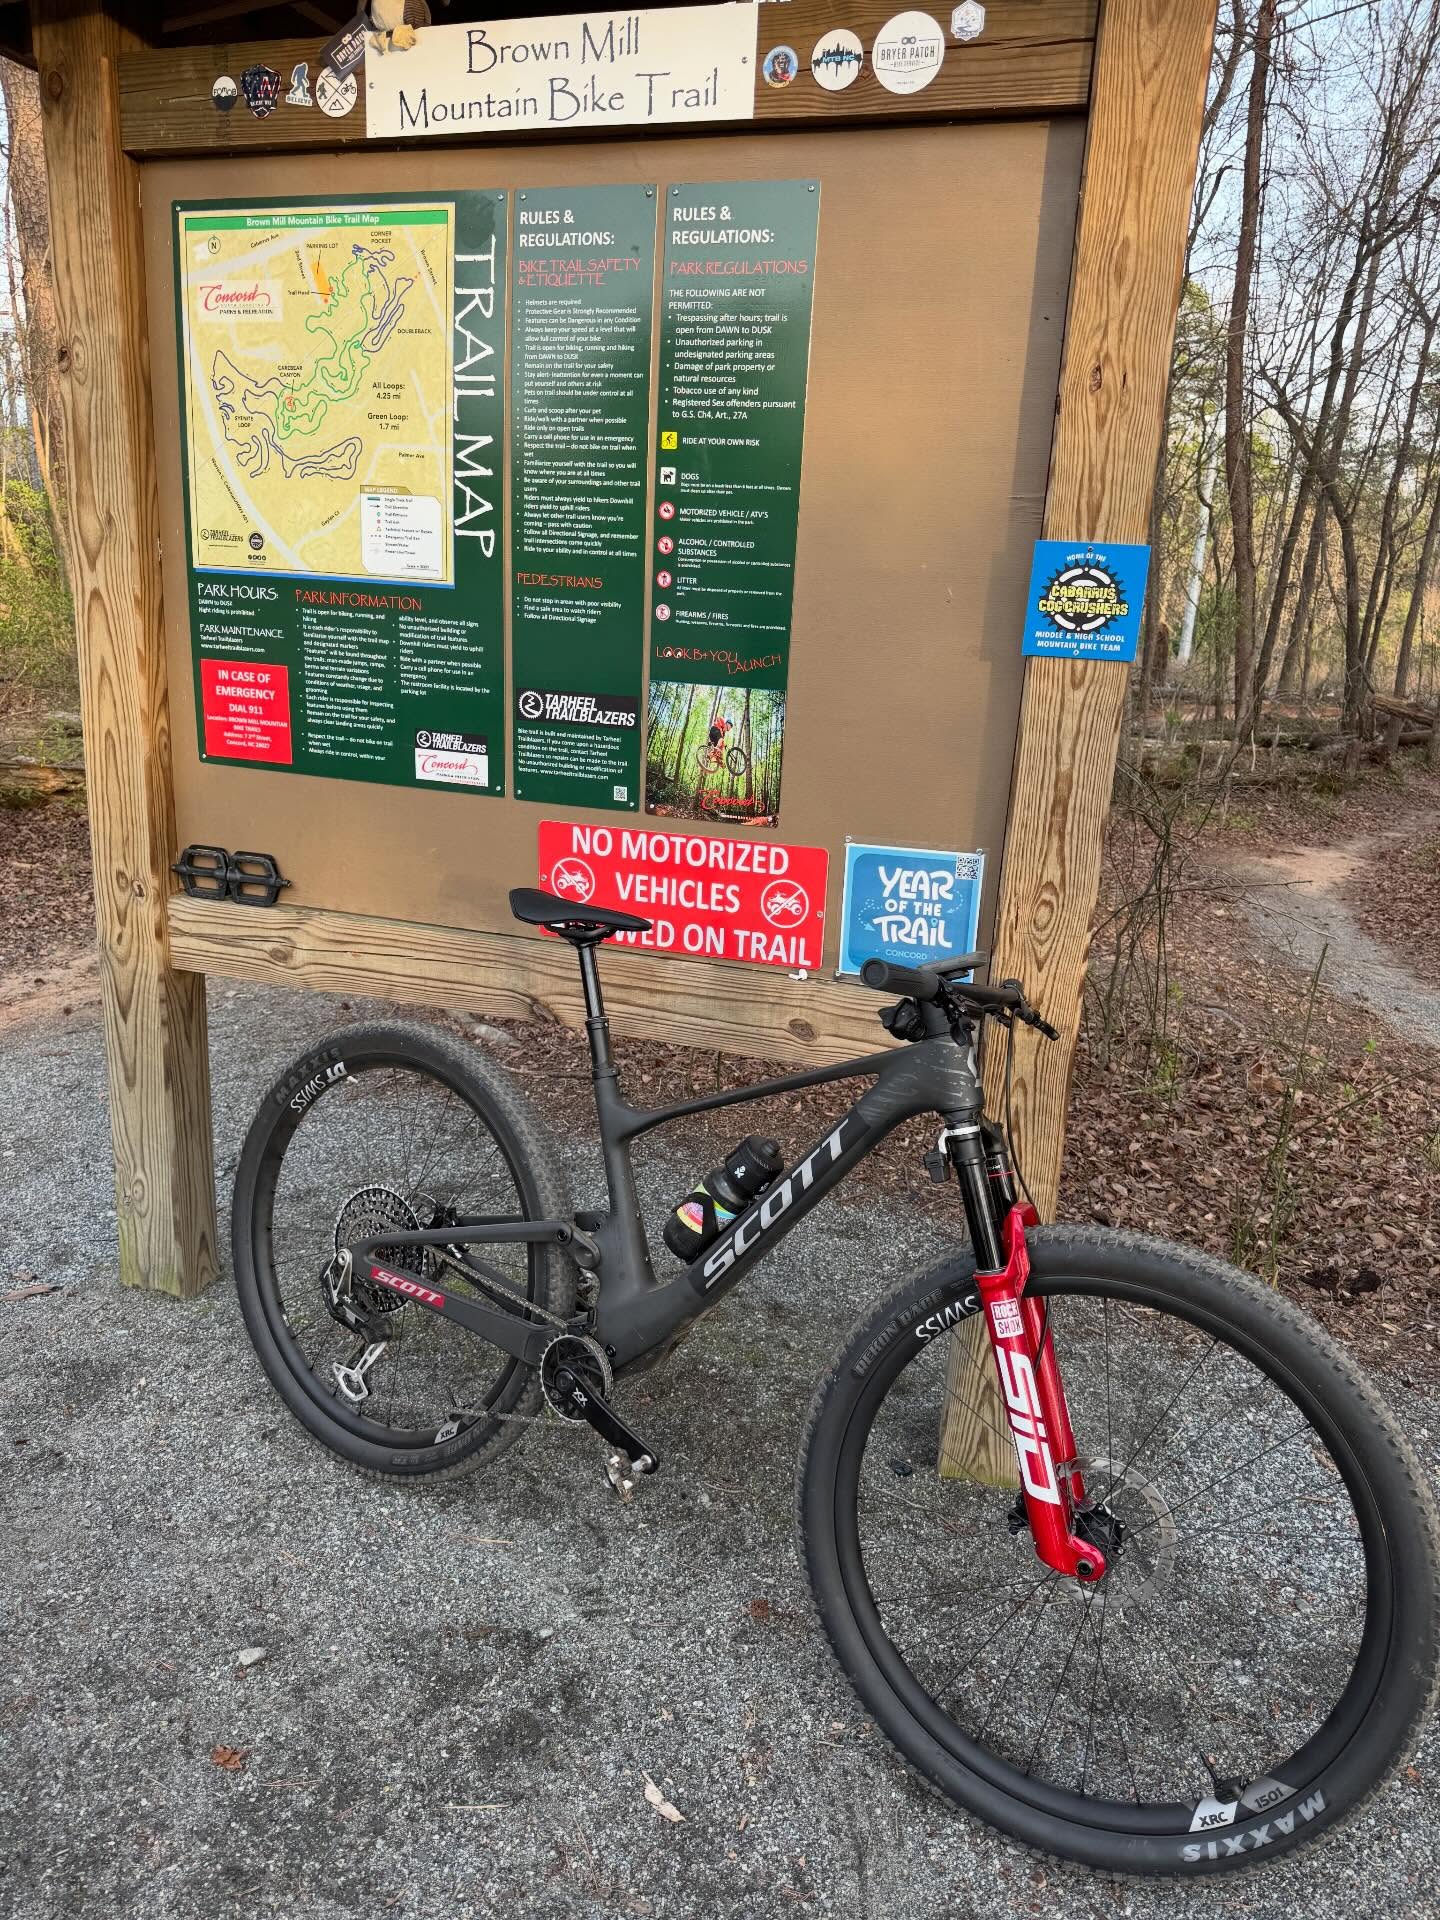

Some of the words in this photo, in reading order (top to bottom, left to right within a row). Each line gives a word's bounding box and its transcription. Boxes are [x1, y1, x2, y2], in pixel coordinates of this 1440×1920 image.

[466, 29, 569, 74] Brown
[581, 16, 639, 64] Mill
[881, 47, 907, 60] BRYER
[910, 45, 935, 59] PATCH
[822, 55, 841, 63] MTB
[288, 96, 311, 105] BELIEVE
[399, 88, 538, 129] Mountain
[548, 74, 624, 121] Bike
[635, 67, 718, 116] Trail
[247, 218, 270, 226] Brown
[272, 217, 286, 225] Mill
[288, 216, 322, 224] Mountain
[326, 216, 342, 224] Bike
[362, 215, 379, 223] Map
[520, 210, 560, 224] RULES
[564, 210, 574, 223] &
[673, 207, 716, 221] RULES
[720, 206, 732, 220] &
[520, 232, 615, 247] REGULATIONS:
[672, 229, 774, 244] REGULATIONS:
[519, 260, 548, 273] BIKE
[550, 259, 586, 272] TRAIL
[587, 258, 641, 271] SAFETY
[670, 261, 704, 274] PARK
[706, 260, 808, 274] REGULATIONS
[526, 272, 608, 286] ETIQUETTE
[200, 283, 270, 311] Concord
[669, 289, 684, 297] THE
[686, 289, 730, 297] FOLLOWING
[668, 302, 714, 310] PERMITTED:
[676, 314, 718, 323] Trespassing
[740, 314, 762, 322] hours;
[454, 234, 497, 421] TRAIL
[675, 338, 724, 346] Unauthorized
[726, 339, 754, 348] parking
[383, 382, 406, 391] Loops:
[673, 386, 702, 394] Tobacco
[728, 388, 740, 396] any
[389, 413, 409, 422] Loop:
[726, 438, 744, 446] OWN
[454, 434, 496, 558] MAP
[680, 508, 718, 516] MOTORIZED
[719, 509, 744, 517] VEHICLE
[679, 538, 707, 546] ALCOHOL
[714, 540, 754, 548] CONTROLLED
[517, 572, 603, 589] PEDESTRIANS
[198, 583, 229, 597] PARK
[231, 586, 278, 600] HOURS:
[1051, 585, 1116, 599] CABARRUS
[296, 590, 328, 606] PARK
[330, 590, 422, 611] INFORMATION
[676, 610, 706, 618] FIREARMS
[712, 612, 728, 620] FIRES
[1064, 601, 1129, 616] CRUSHERS
[200, 624, 220, 633] PARK
[222, 626, 284, 638] MAINTENANCE
[1075, 632, 1093, 640] HIGH
[1096, 634, 1125, 642] SCHOOL
[656, 646, 693, 660] LOOK
[710, 650, 738, 662] YOU
[728, 655, 781, 674] LAUNCH
[218, 670, 228, 680] IN
[231, 670, 255, 682] CASE
[257, 673, 270, 683] OF
[216, 686, 276, 700] EMERGENCY
[229, 704, 247, 713] DIAL
[249, 705, 262, 714] 911
[545, 694, 597, 711] TARHEEL
[545, 708, 635, 726] TRAILBLAZERS
[432, 732, 463, 743] TARHEEL
[432, 741, 486, 753] TRAILBLAZERS
[418, 754, 478, 775] Concord
[572, 825, 613, 857] NO
[621, 830, 789, 876] MOTORIZED
[878, 866, 954, 900] YEAR
[615, 871, 740, 913] VEHICLES
[885, 900, 908, 912] OF
[914, 902, 942, 916] THE
[683, 924, 725, 951] ON
[733, 930, 812, 966] TRAIL
[886, 950, 928, 960] CONCORD
[326, 1062, 348, 1083] DT
[290, 1074, 326, 1112] SWISS
[703, 1118, 849, 1290] SCOTT
[374, 1268, 443, 1304] SCOTT
[994, 1302, 1019, 1319] ROCK
[915, 1295, 981, 1344] SWISS
[997, 1321, 1024, 1335] SHOX
[995, 1344, 1062, 1505] SID
[440, 1428, 455, 1439] XRC
[1254, 1786, 1284, 1808] 1501
[1183, 1788, 1327, 1863] MAXXIS
[1198, 1811, 1228, 1828] XRC
